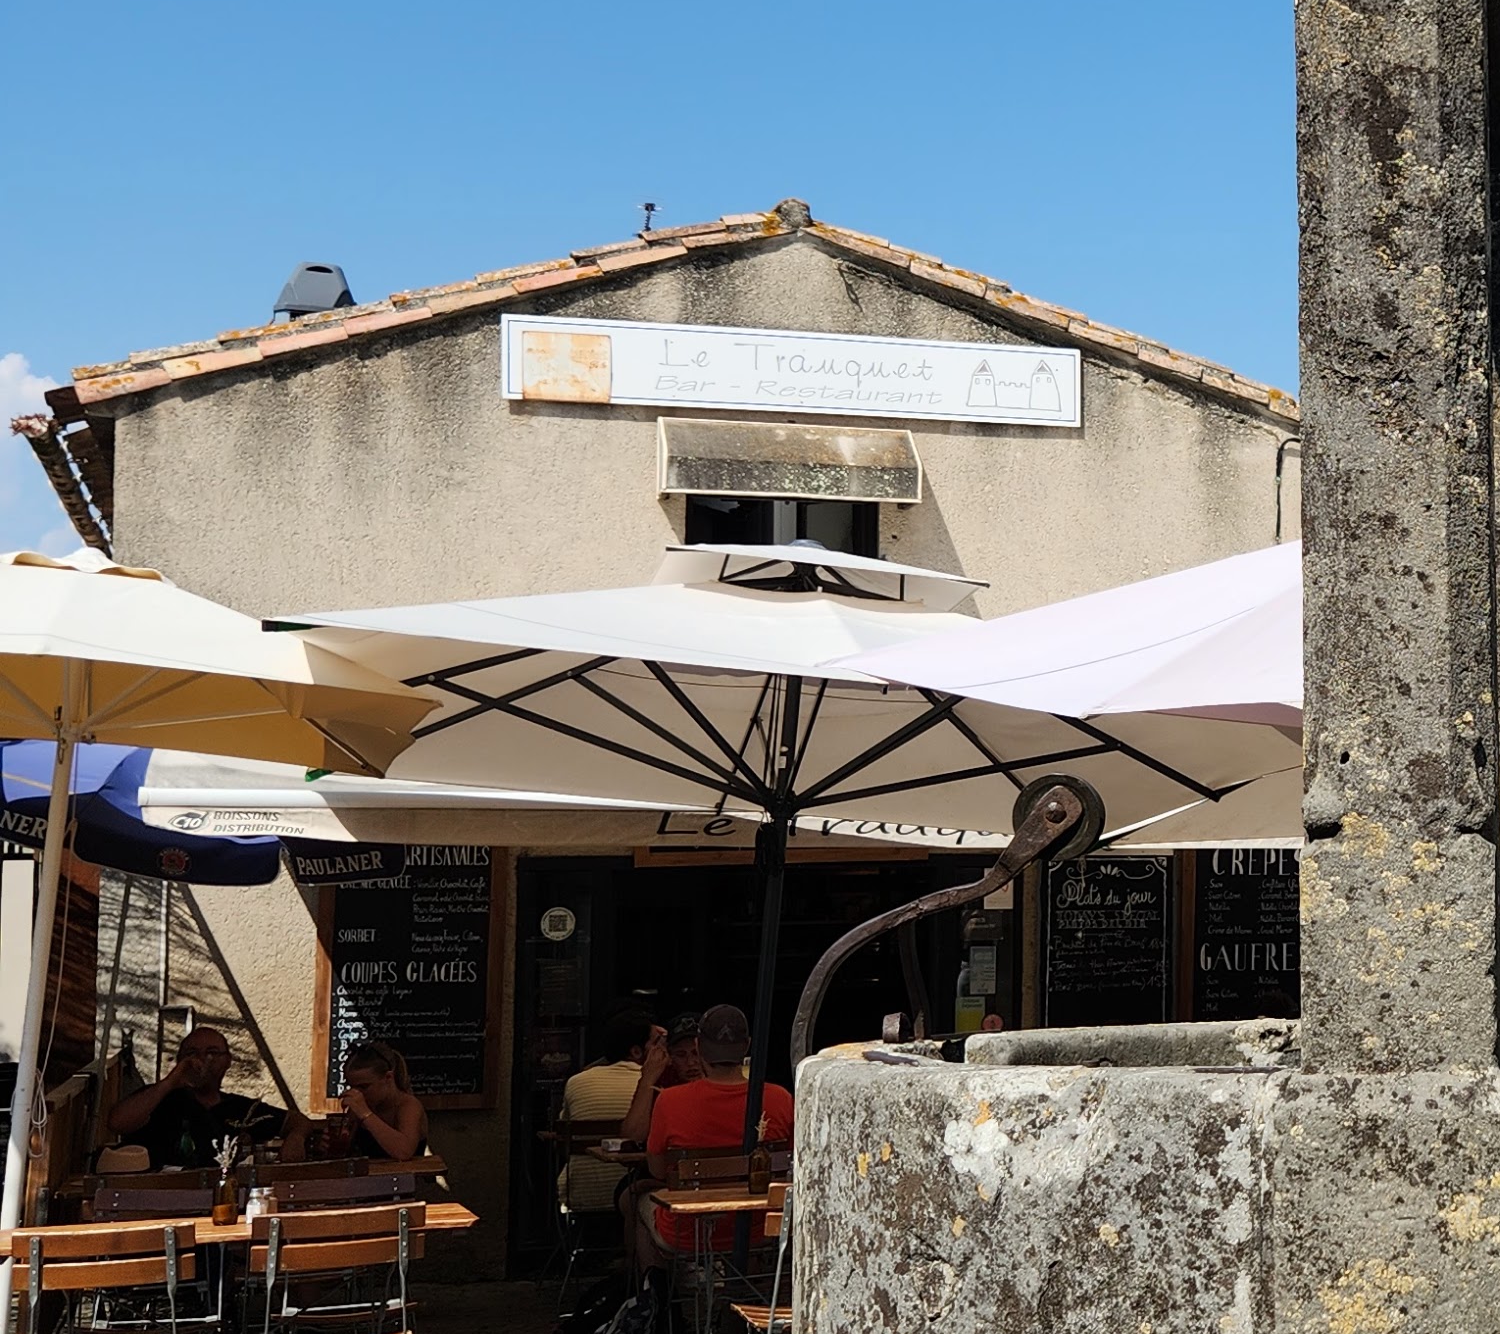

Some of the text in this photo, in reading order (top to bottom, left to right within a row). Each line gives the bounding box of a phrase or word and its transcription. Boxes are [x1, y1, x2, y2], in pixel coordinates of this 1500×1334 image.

[659, 339, 933, 388] Le Trauquet
[655, 375, 716, 392] Bar
[755, 380, 943, 405] Restaurant
[213, 811, 280, 822] BOISSONS
[656, 811, 737, 836] Le
[213, 824, 305, 835] DISTRIBUTION
[296, 850, 384, 876] PAULANER
[406, 846, 490, 866] RTISANALES
[1103, 889, 1121, 906] du
[1123, 888, 1157, 916] jour
[337, 928, 377, 943] SORBET
[341, 958, 477, 984] COUPES GLACÉES
